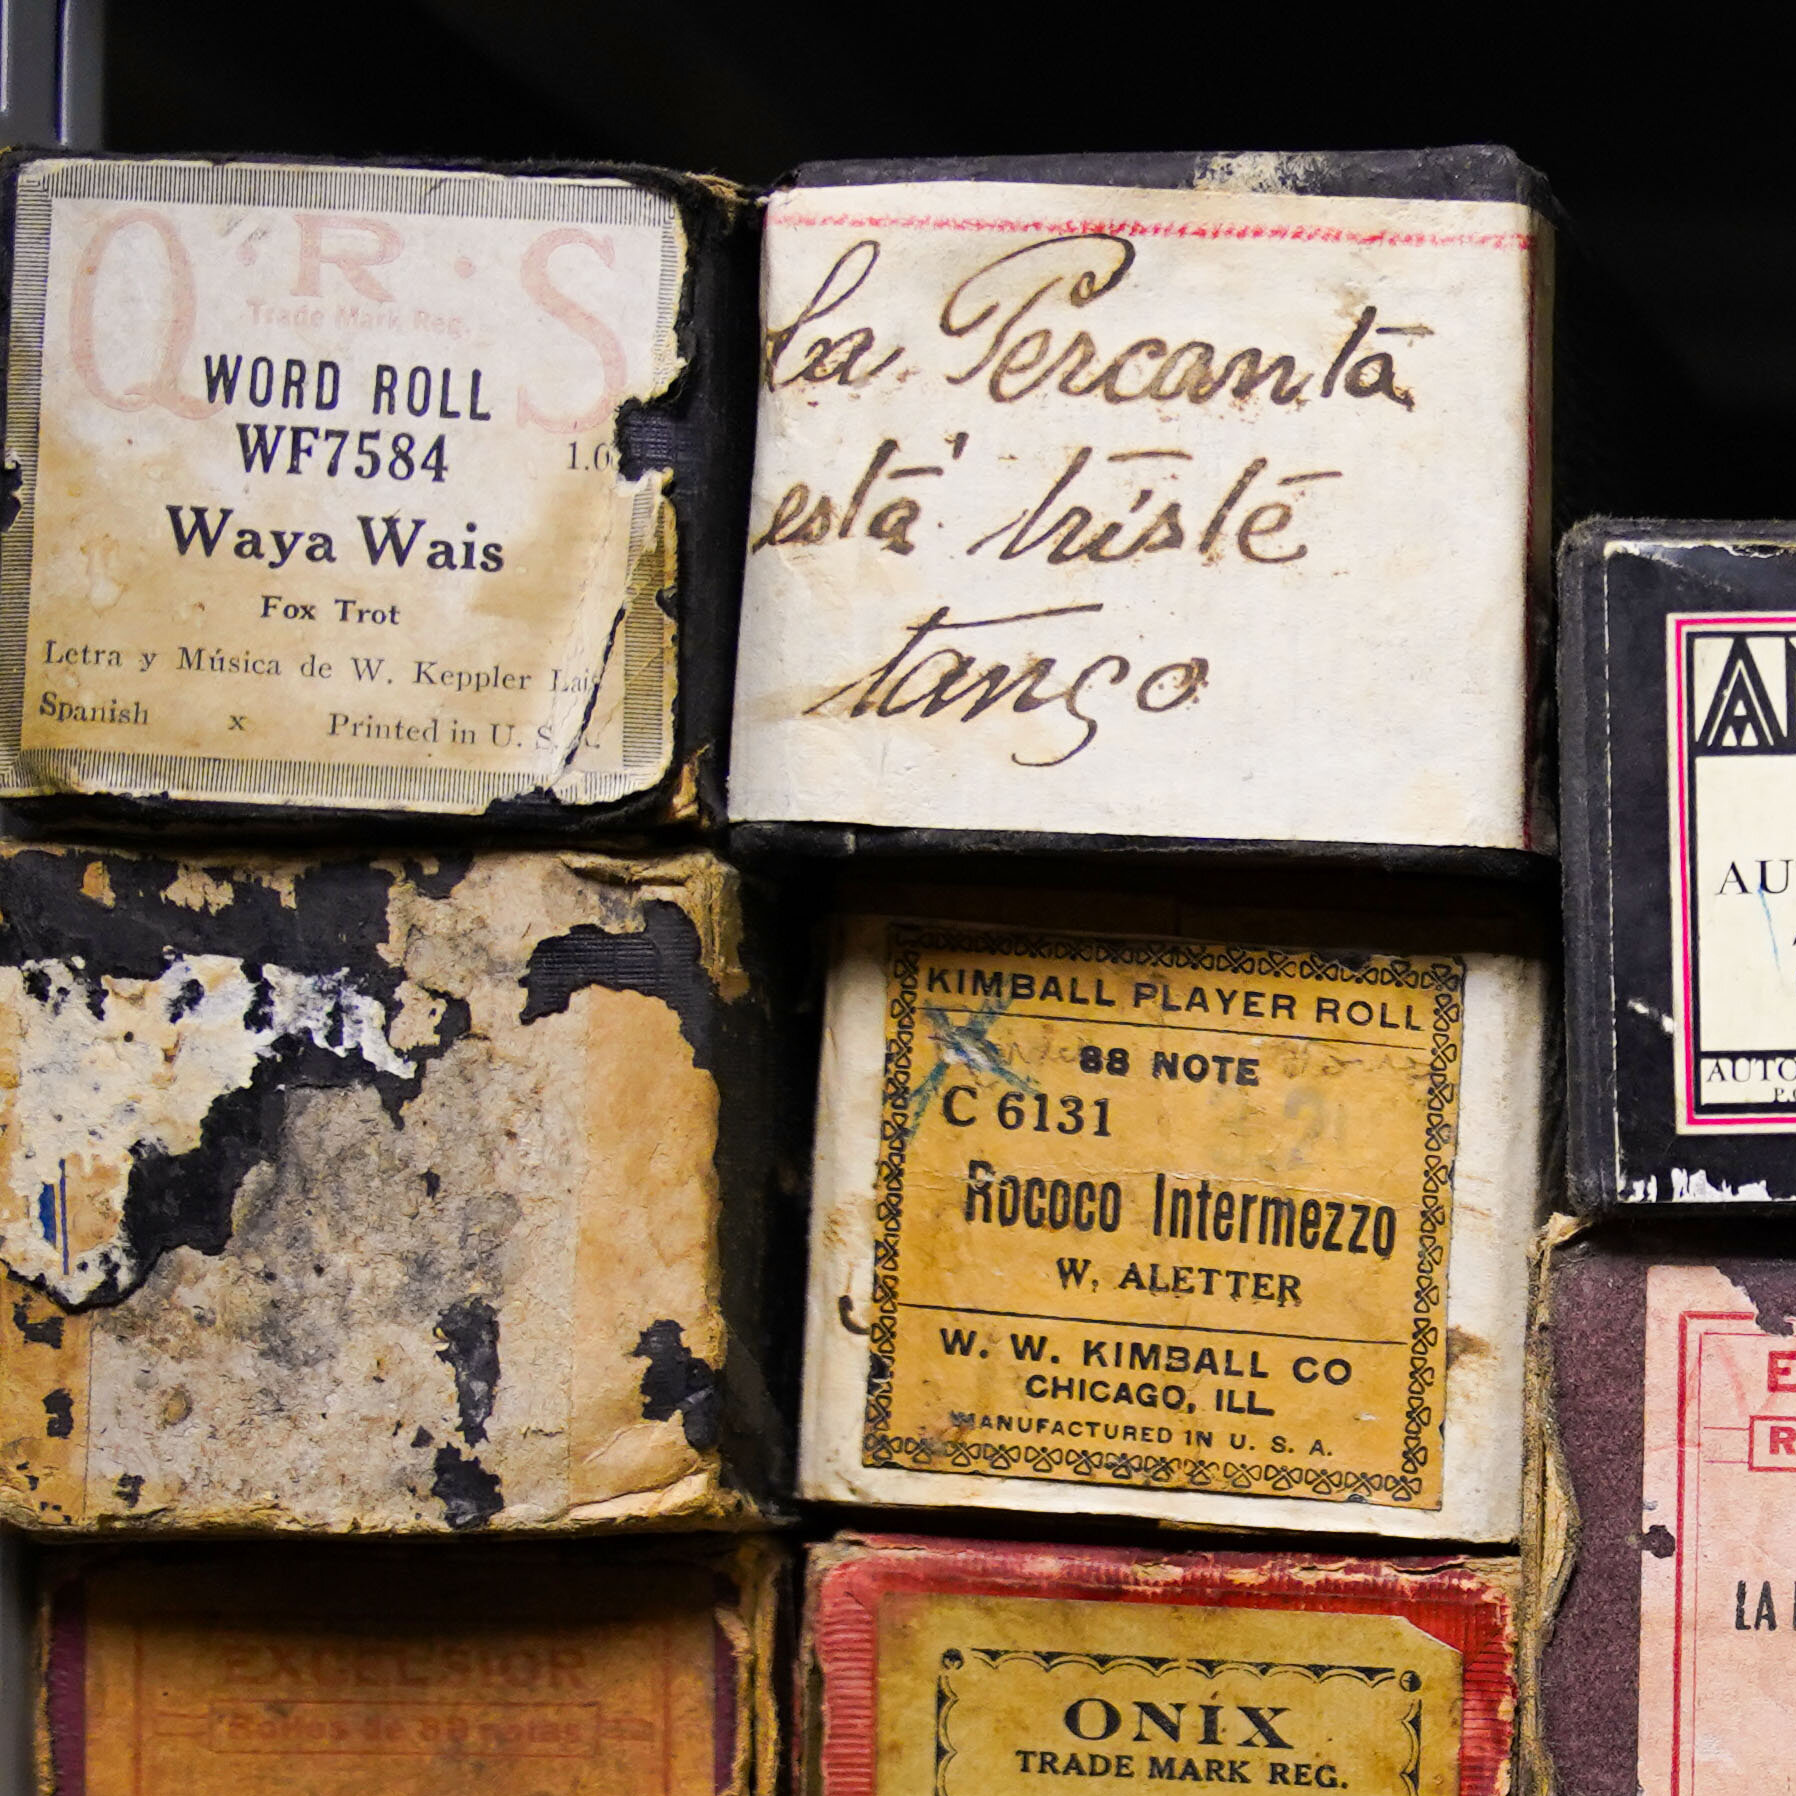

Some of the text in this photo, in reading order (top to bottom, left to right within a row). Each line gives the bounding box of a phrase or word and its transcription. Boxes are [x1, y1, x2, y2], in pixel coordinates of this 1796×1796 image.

[205, 354, 492, 421] WORD ROLL
[236, 423, 448, 483] WF7584
[968, 446, 1342, 563] triste
[167, 505, 505, 573] Waya Wais
[261, 595, 400, 627] Fox Trot
[804, 605, 1209, 767] tango
[926, 967, 1421, 1030] KIMBALL PLAYER ROLL
[1080, 1047, 1129, 1076] 88
[1153, 1052, 1260, 1086] NOTE
[943, 1086, 1112, 1137] C 6131
[965, 1160, 1395, 1257] Rococo Intermezzo
[1064, 1697, 1293, 1749] ONIX
[1017, 1750, 1348, 1789] TRADE MARK REG.
